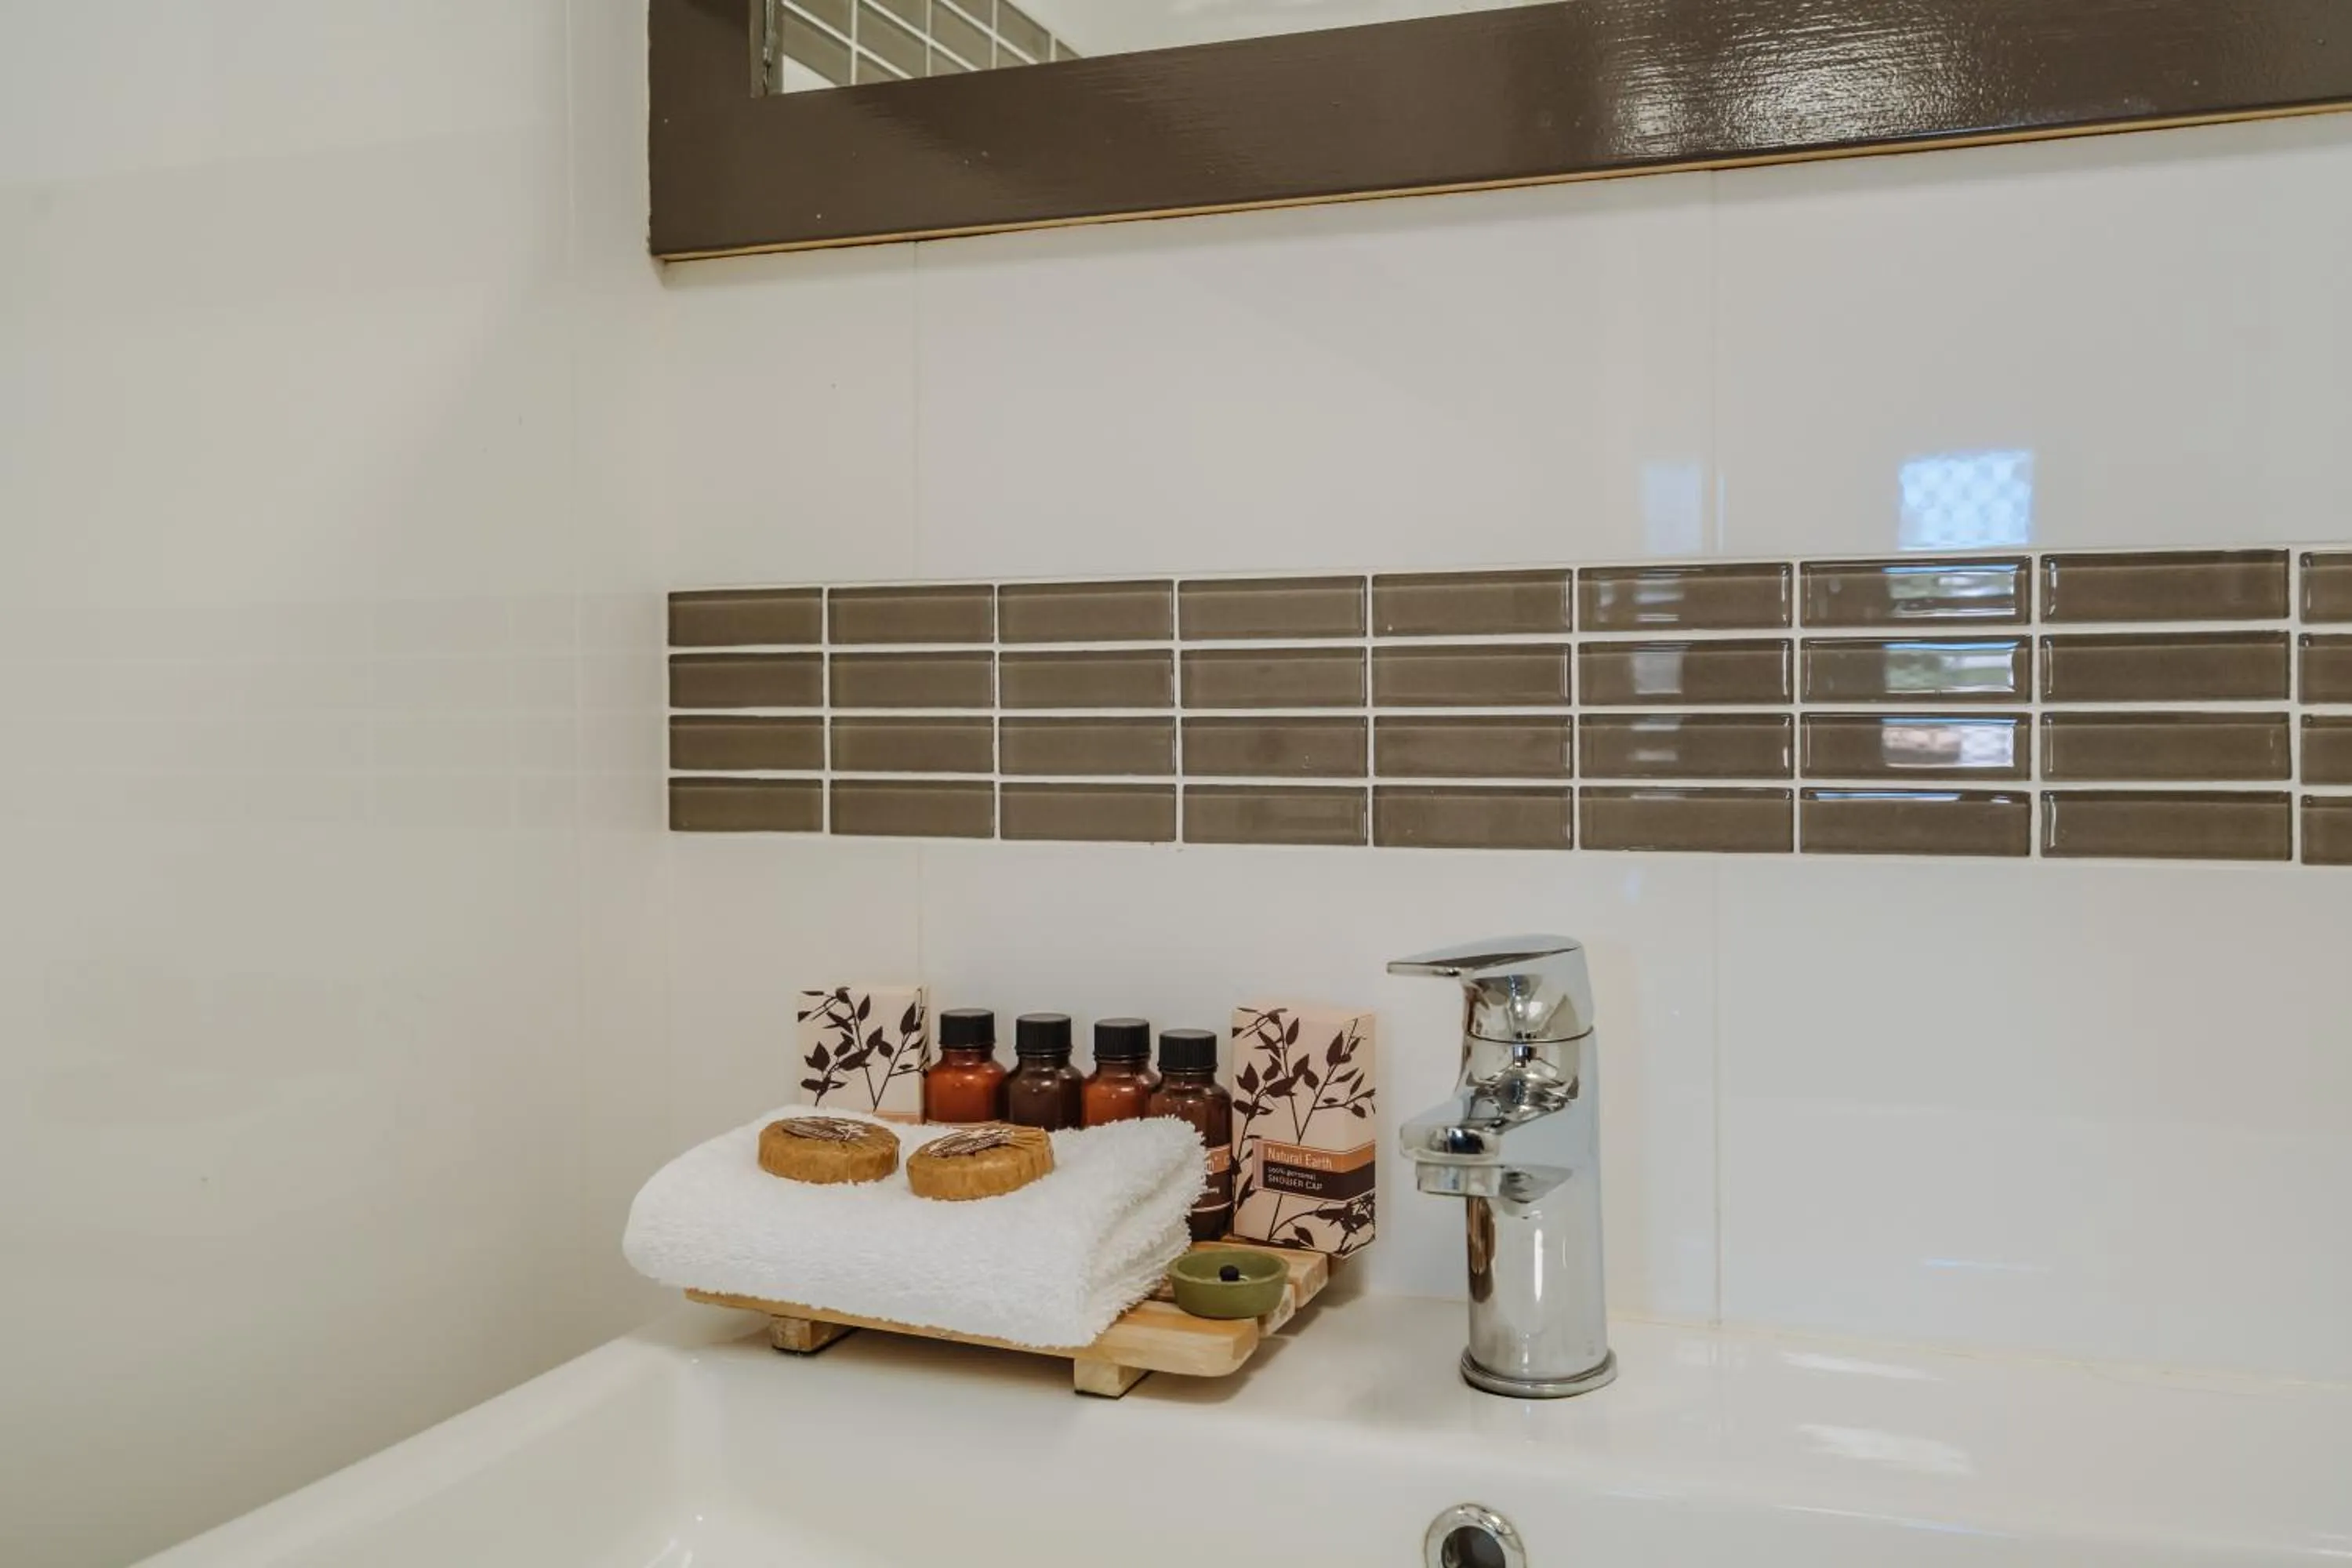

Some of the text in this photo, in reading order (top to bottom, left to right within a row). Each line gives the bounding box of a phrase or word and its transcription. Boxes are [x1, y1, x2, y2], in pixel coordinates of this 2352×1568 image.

[1268, 1147, 1333, 1171] Natural Earth
[1268, 1174, 1323, 1191] SHOWER CAP
